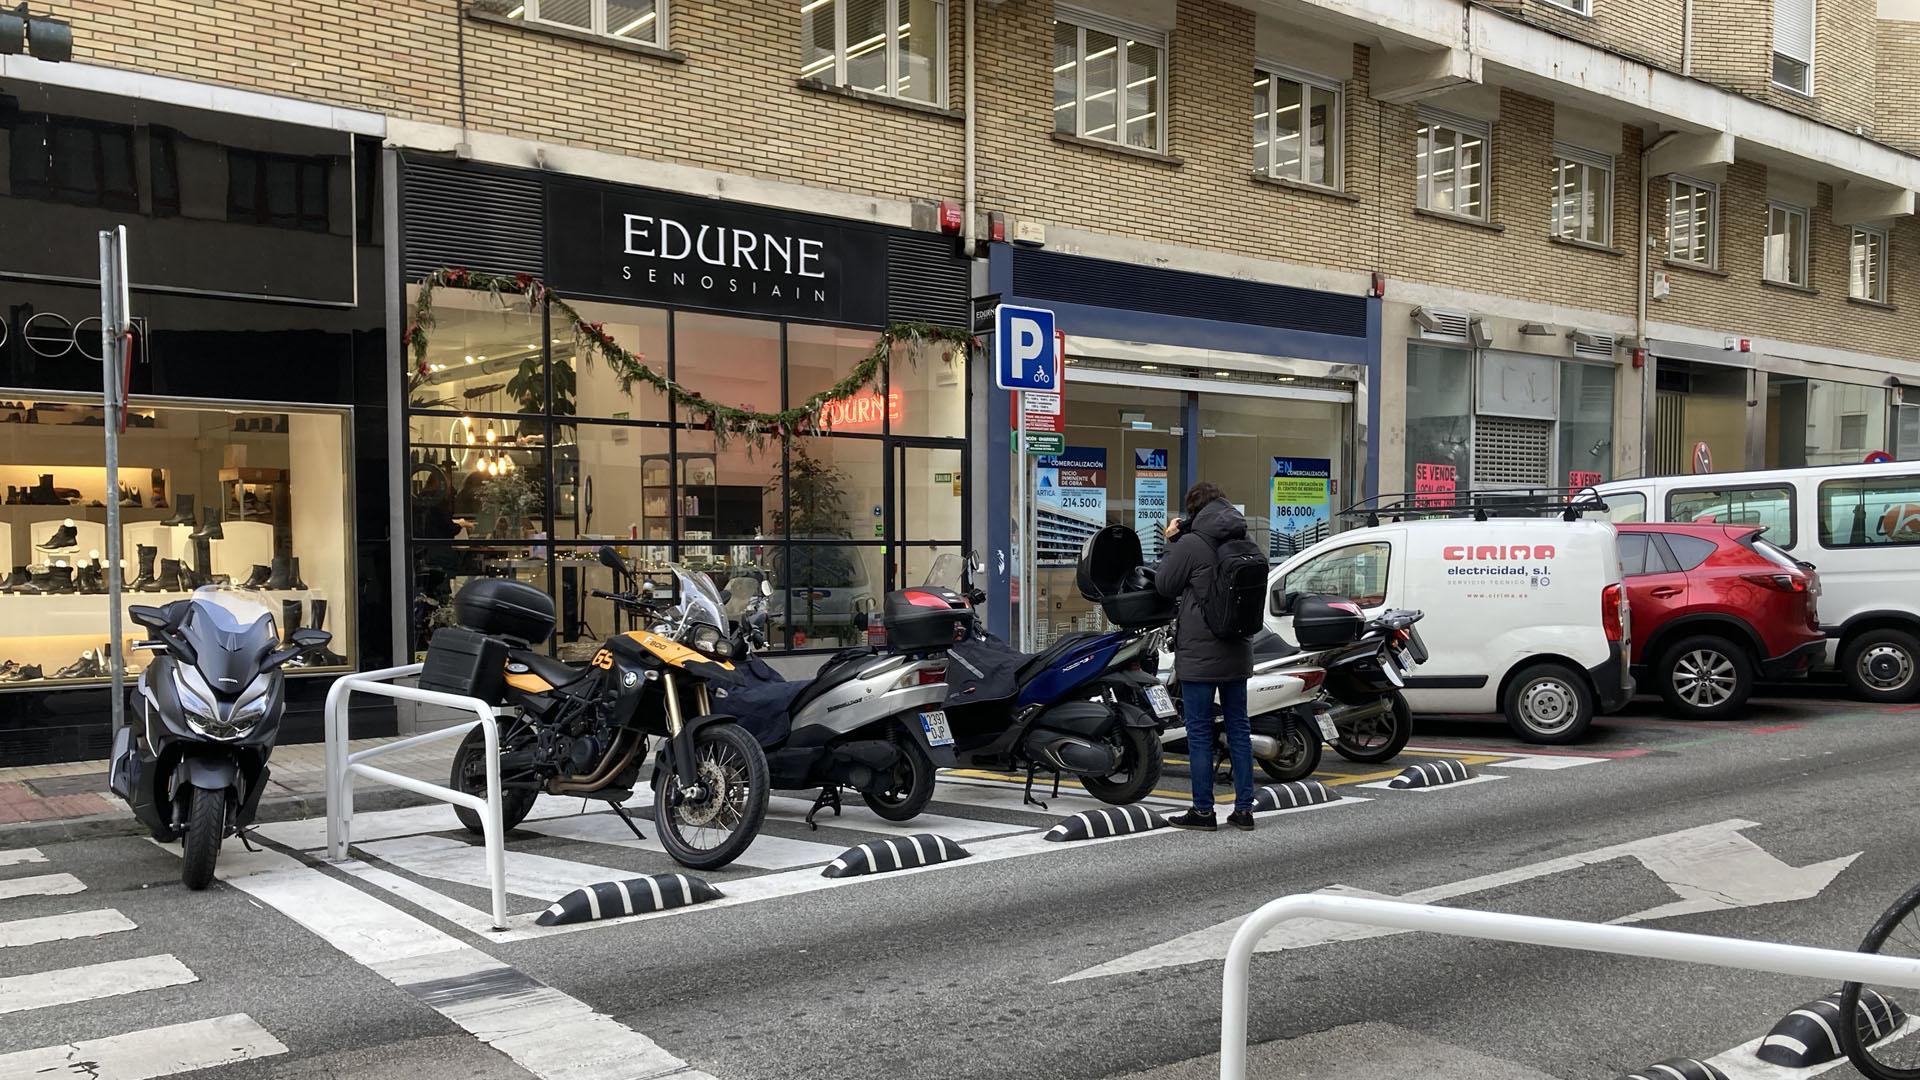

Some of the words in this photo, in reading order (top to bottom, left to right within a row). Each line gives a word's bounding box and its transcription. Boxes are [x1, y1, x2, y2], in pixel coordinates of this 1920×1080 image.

[623, 213, 825, 279] EDURNE
[622, 266, 825, 302] SENOSIAIN
[976, 309, 995, 319] EDURN
[1011, 317, 1044, 379] P
[1051, 460, 1104, 468] COMERCIALIZACIÓN
[1148, 454, 1165, 467] EN
[1277, 461, 1292, 473] EN
[1417, 465, 1427, 480] SE
[1429, 466, 1456, 481] VENDE
[1570, 472, 1578, 486] SE
[1580, 474, 1601, 486] VENDE
[1447, 566, 1529, 577] electricidad,
[1532, 566, 1551, 576] s.l.
[591, 649, 614, 671] GS
[926, 712, 946, 726] 2397
